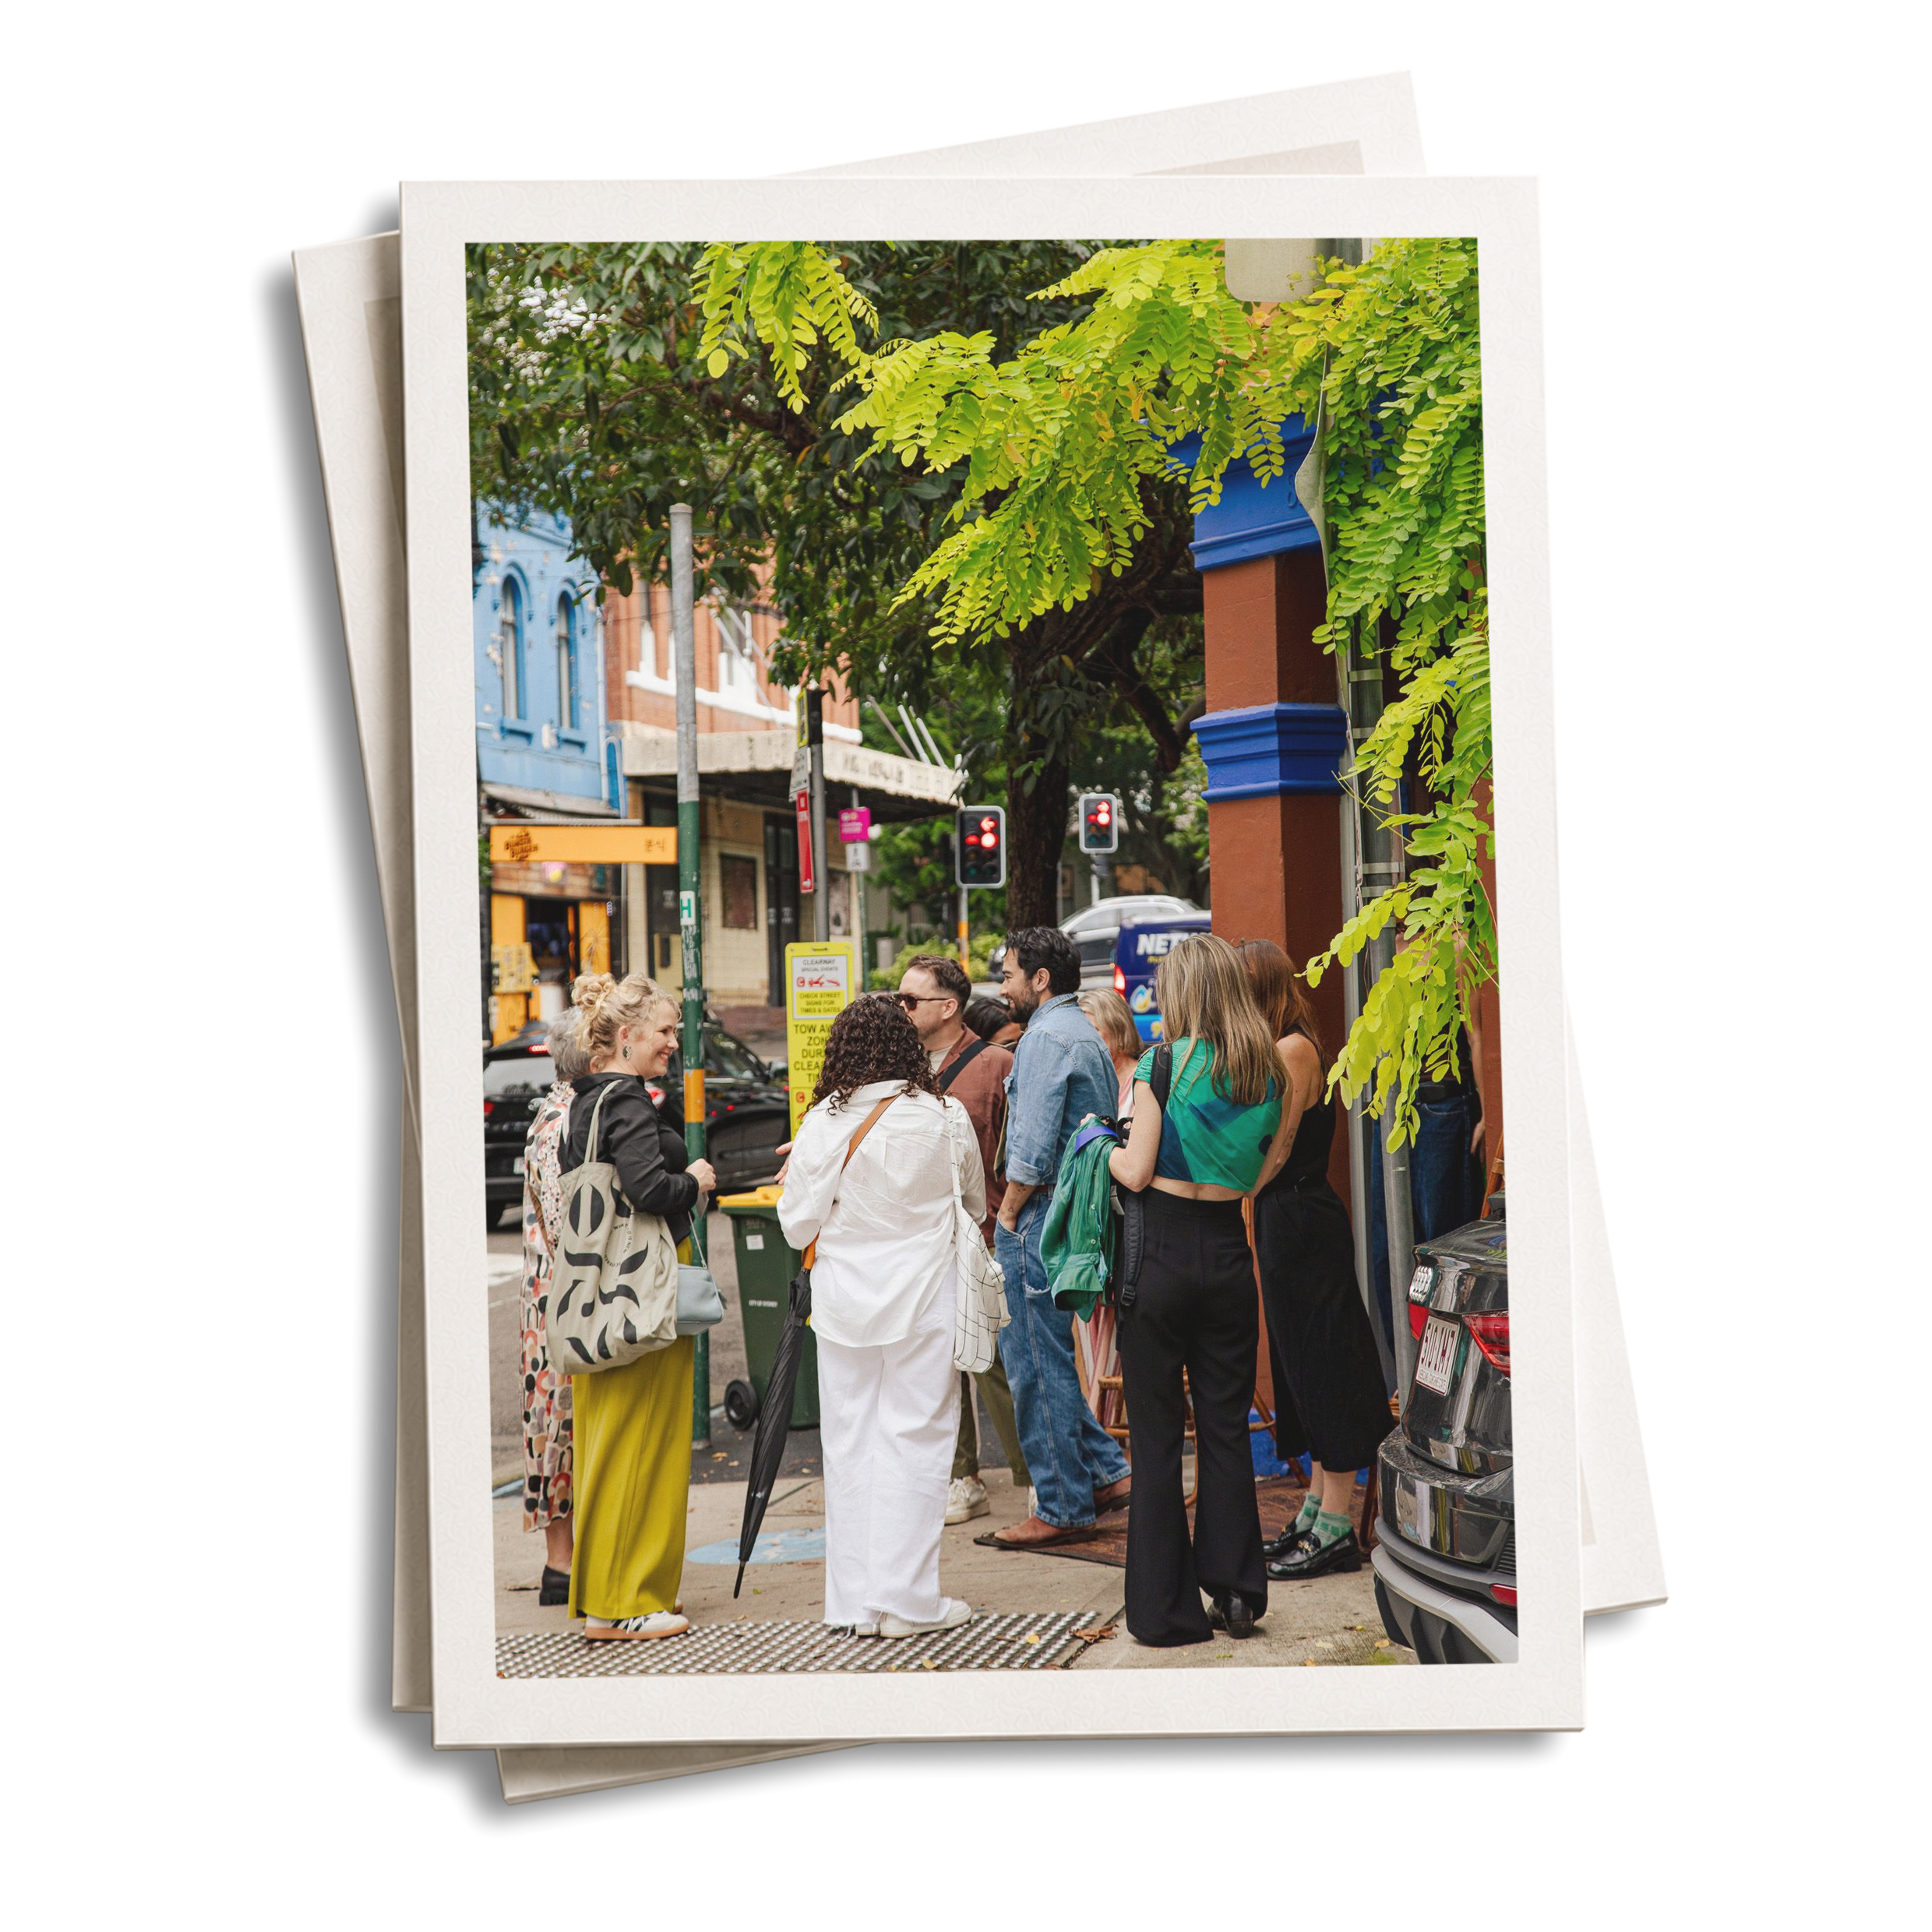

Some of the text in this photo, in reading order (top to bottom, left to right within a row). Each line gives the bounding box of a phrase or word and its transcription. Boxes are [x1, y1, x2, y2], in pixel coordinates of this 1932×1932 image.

[680, 898, 692, 919] H
[793, 1024, 816, 1034] TOW
[807, 1036, 827, 1046] ZON
[802, 1049, 824, 1058] DUR
[793, 1060, 823, 1070] CLEA
